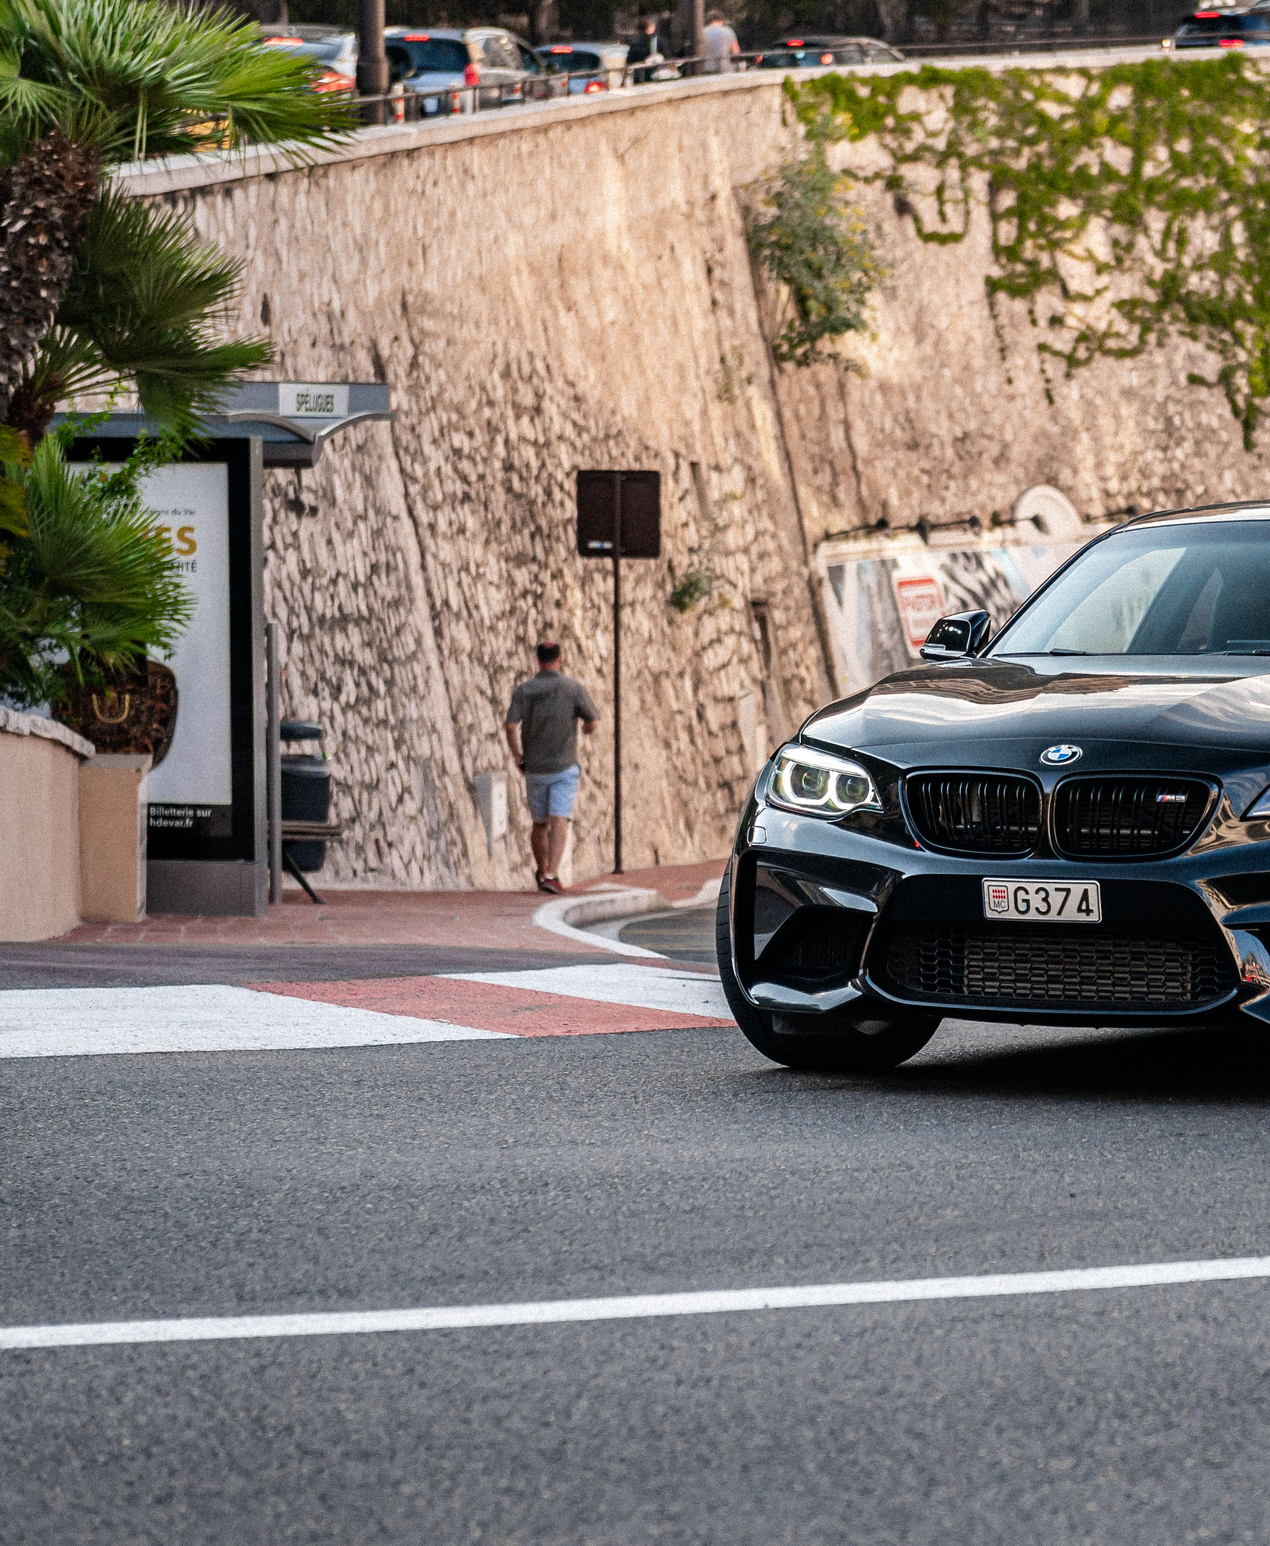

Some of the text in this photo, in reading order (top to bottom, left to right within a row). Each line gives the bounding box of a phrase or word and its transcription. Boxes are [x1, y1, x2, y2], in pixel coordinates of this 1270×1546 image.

[149, 805, 213, 818] Billetterie sur
[149, 817, 194, 828] hdevar.fr
[993, 886, 1094, 917] MC G374
